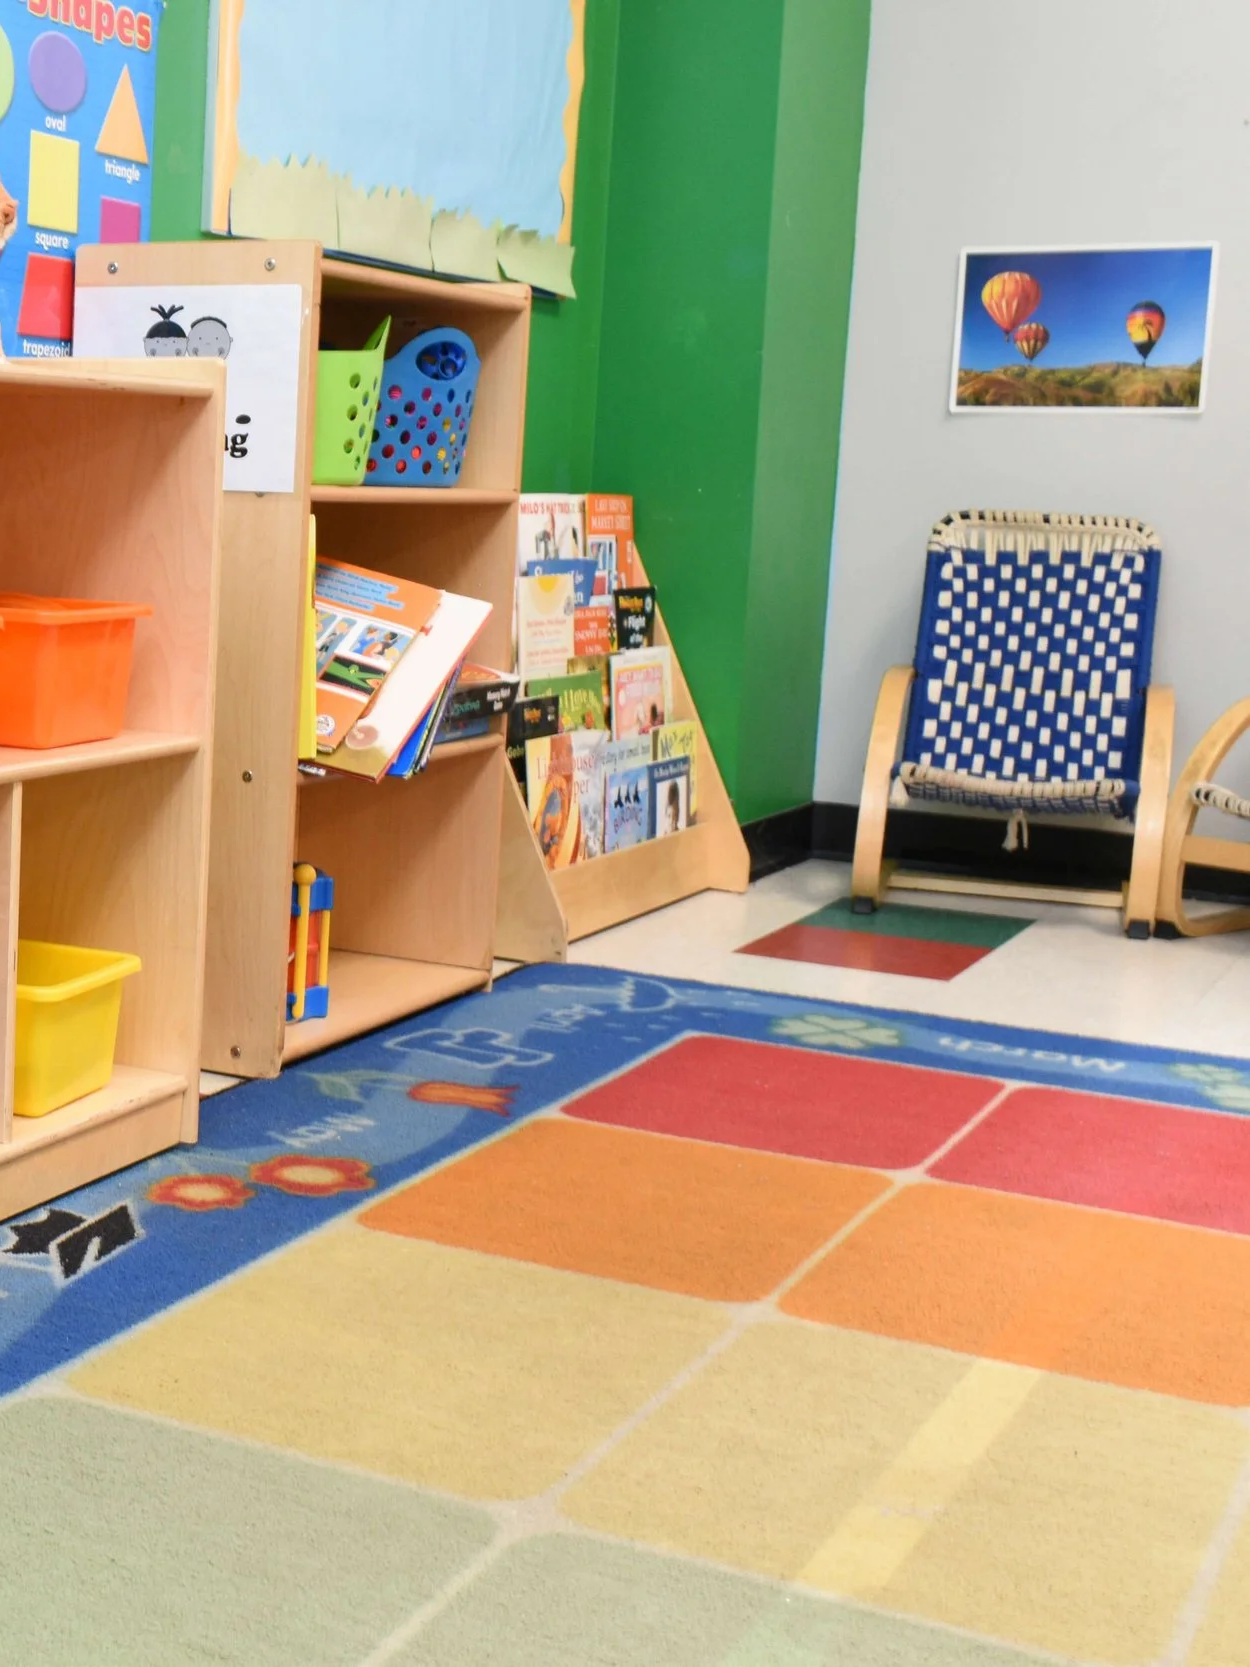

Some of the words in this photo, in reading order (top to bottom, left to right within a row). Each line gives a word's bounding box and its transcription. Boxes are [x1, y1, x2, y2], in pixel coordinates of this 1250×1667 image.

[45, 115, 67, 132] oval
[104, 160, 141, 184] triangle
[35, 231, 70, 250] square
[23, 339, 71, 357] trapezoid
[939, 1036, 1127, 1073] March
[264, 1112, 376, 1149] May
